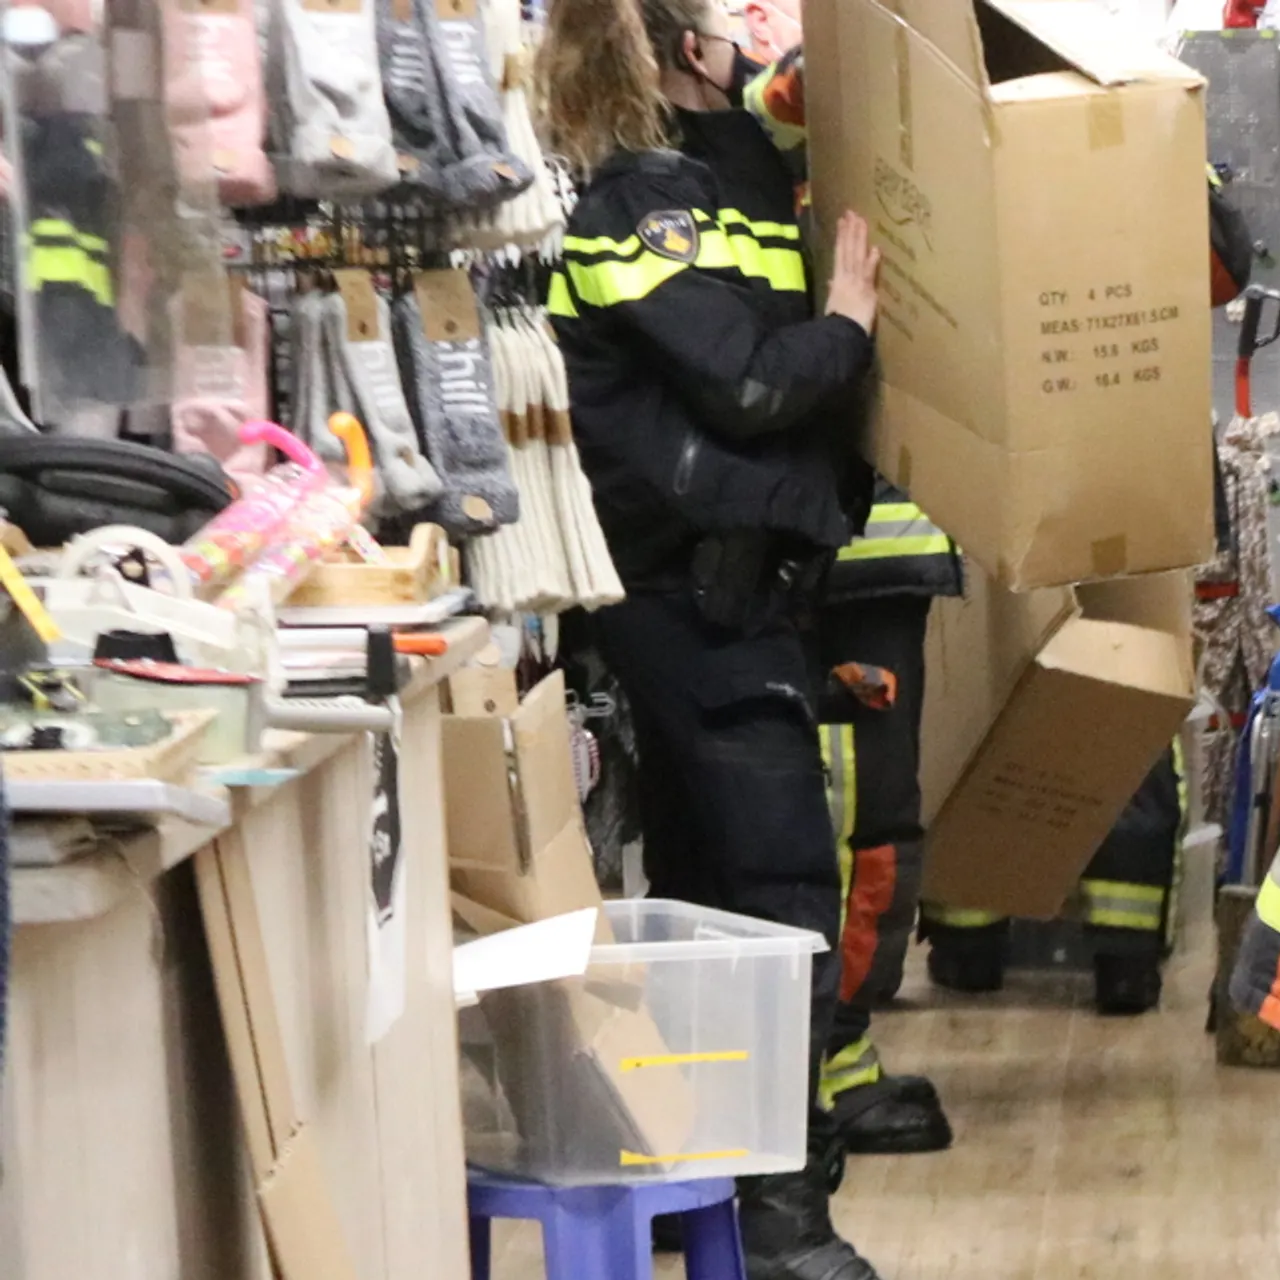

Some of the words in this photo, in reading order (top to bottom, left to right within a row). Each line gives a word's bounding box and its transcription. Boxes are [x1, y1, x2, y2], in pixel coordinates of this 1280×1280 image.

[1105, 283, 1132, 299] PCS
[1131, 337, 1159, 354] KGS
[1133, 366, 1161, 382] KGS
